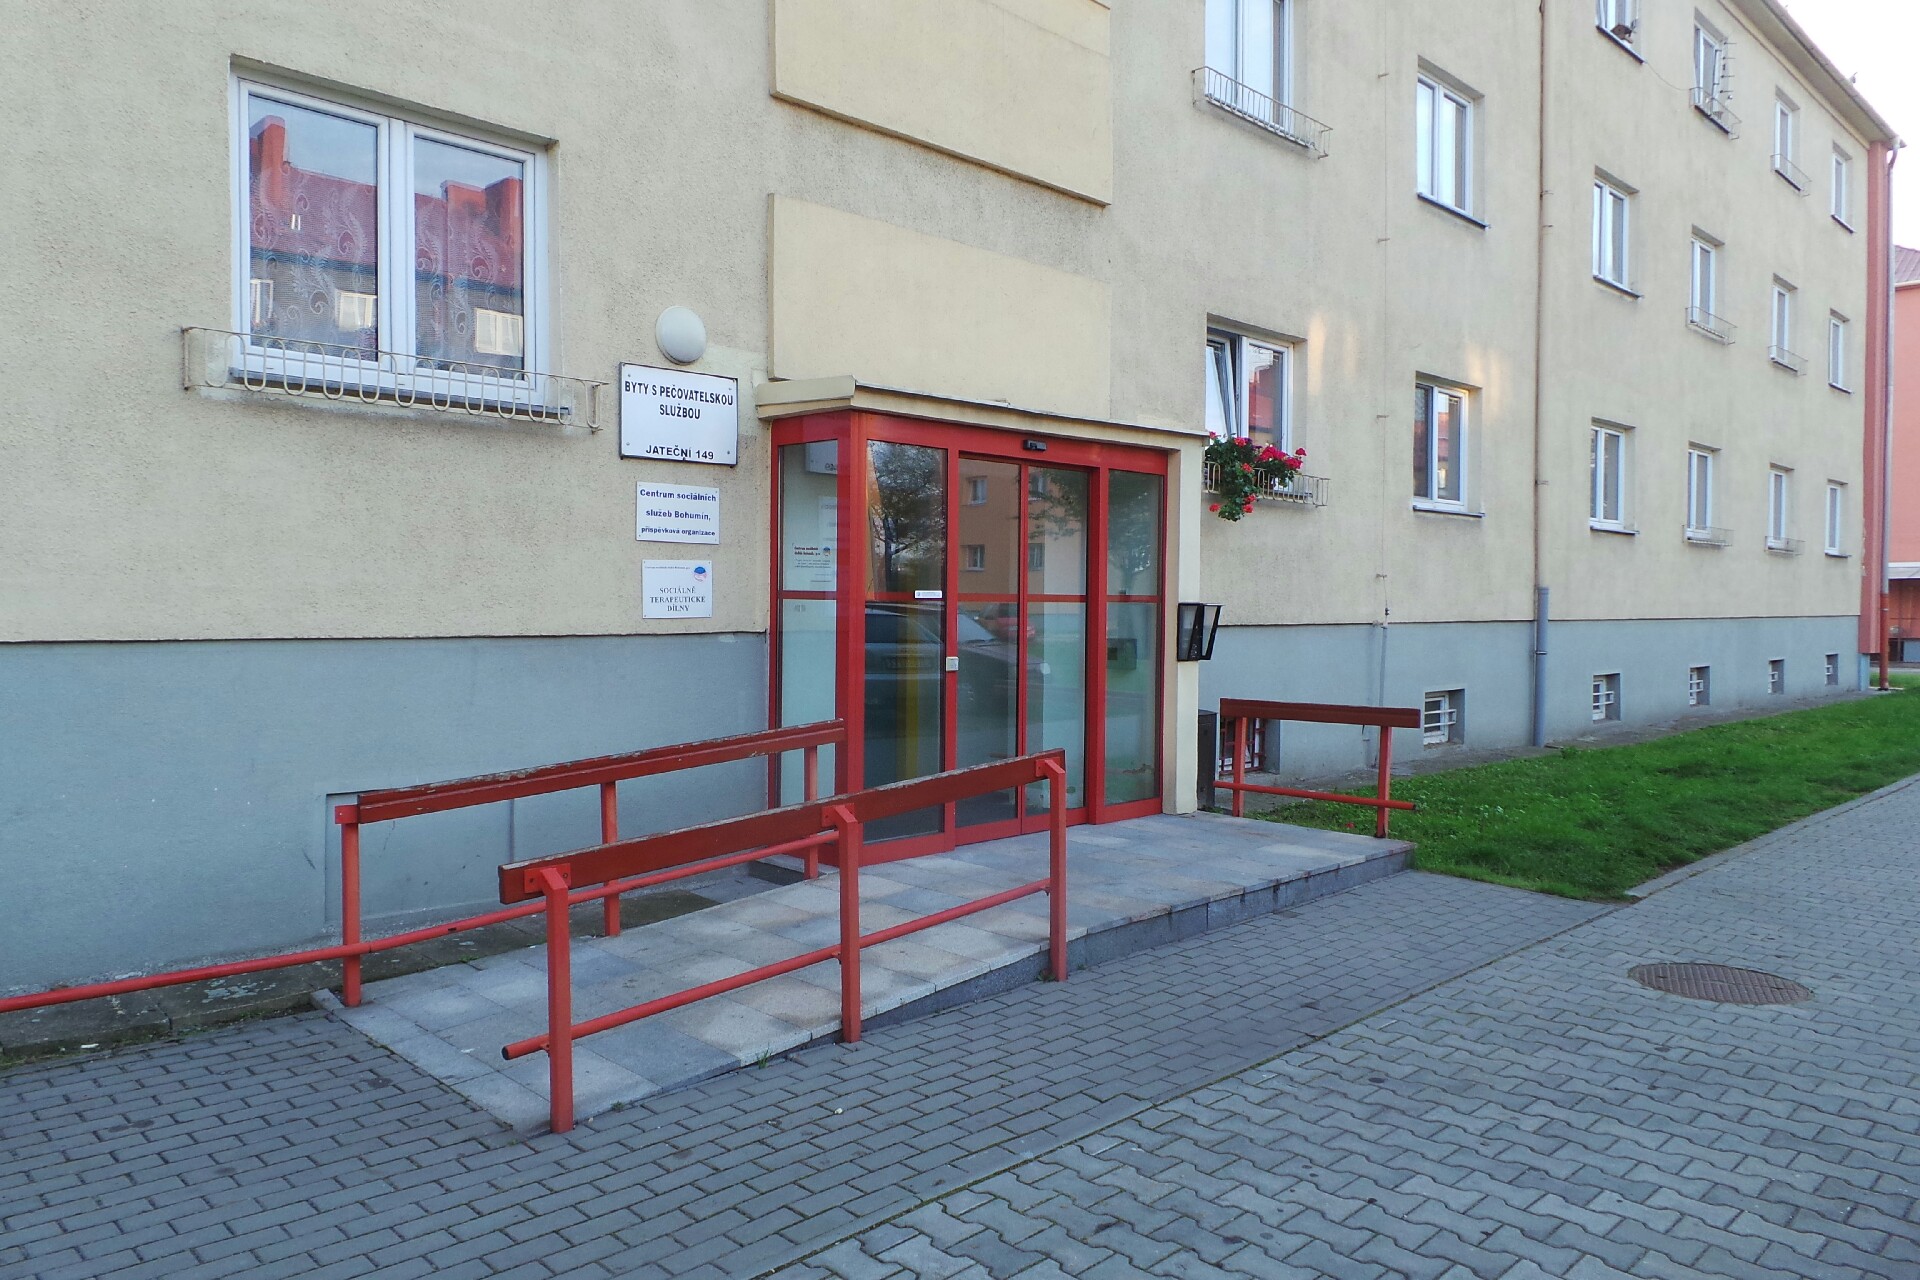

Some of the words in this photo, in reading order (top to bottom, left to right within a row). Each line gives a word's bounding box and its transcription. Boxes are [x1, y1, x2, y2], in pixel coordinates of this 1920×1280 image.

[625, 381, 648, 394] BYTY
[652, 385, 657, 395] S
[660, 384, 733, 405] PEČOVATELSKOU
[660, 403, 701, 419] SLUŽBOU
[646, 445, 692, 458] JATEČNÍ
[696, 450, 714, 460] 149
[640, 489, 674, 498] Centrum
[677, 493, 716, 502] sociálních
[646, 509, 672, 517] služeb
[675, 510, 711, 521] Bohumín,
[667, 604, 690, 612] DÍLNY
